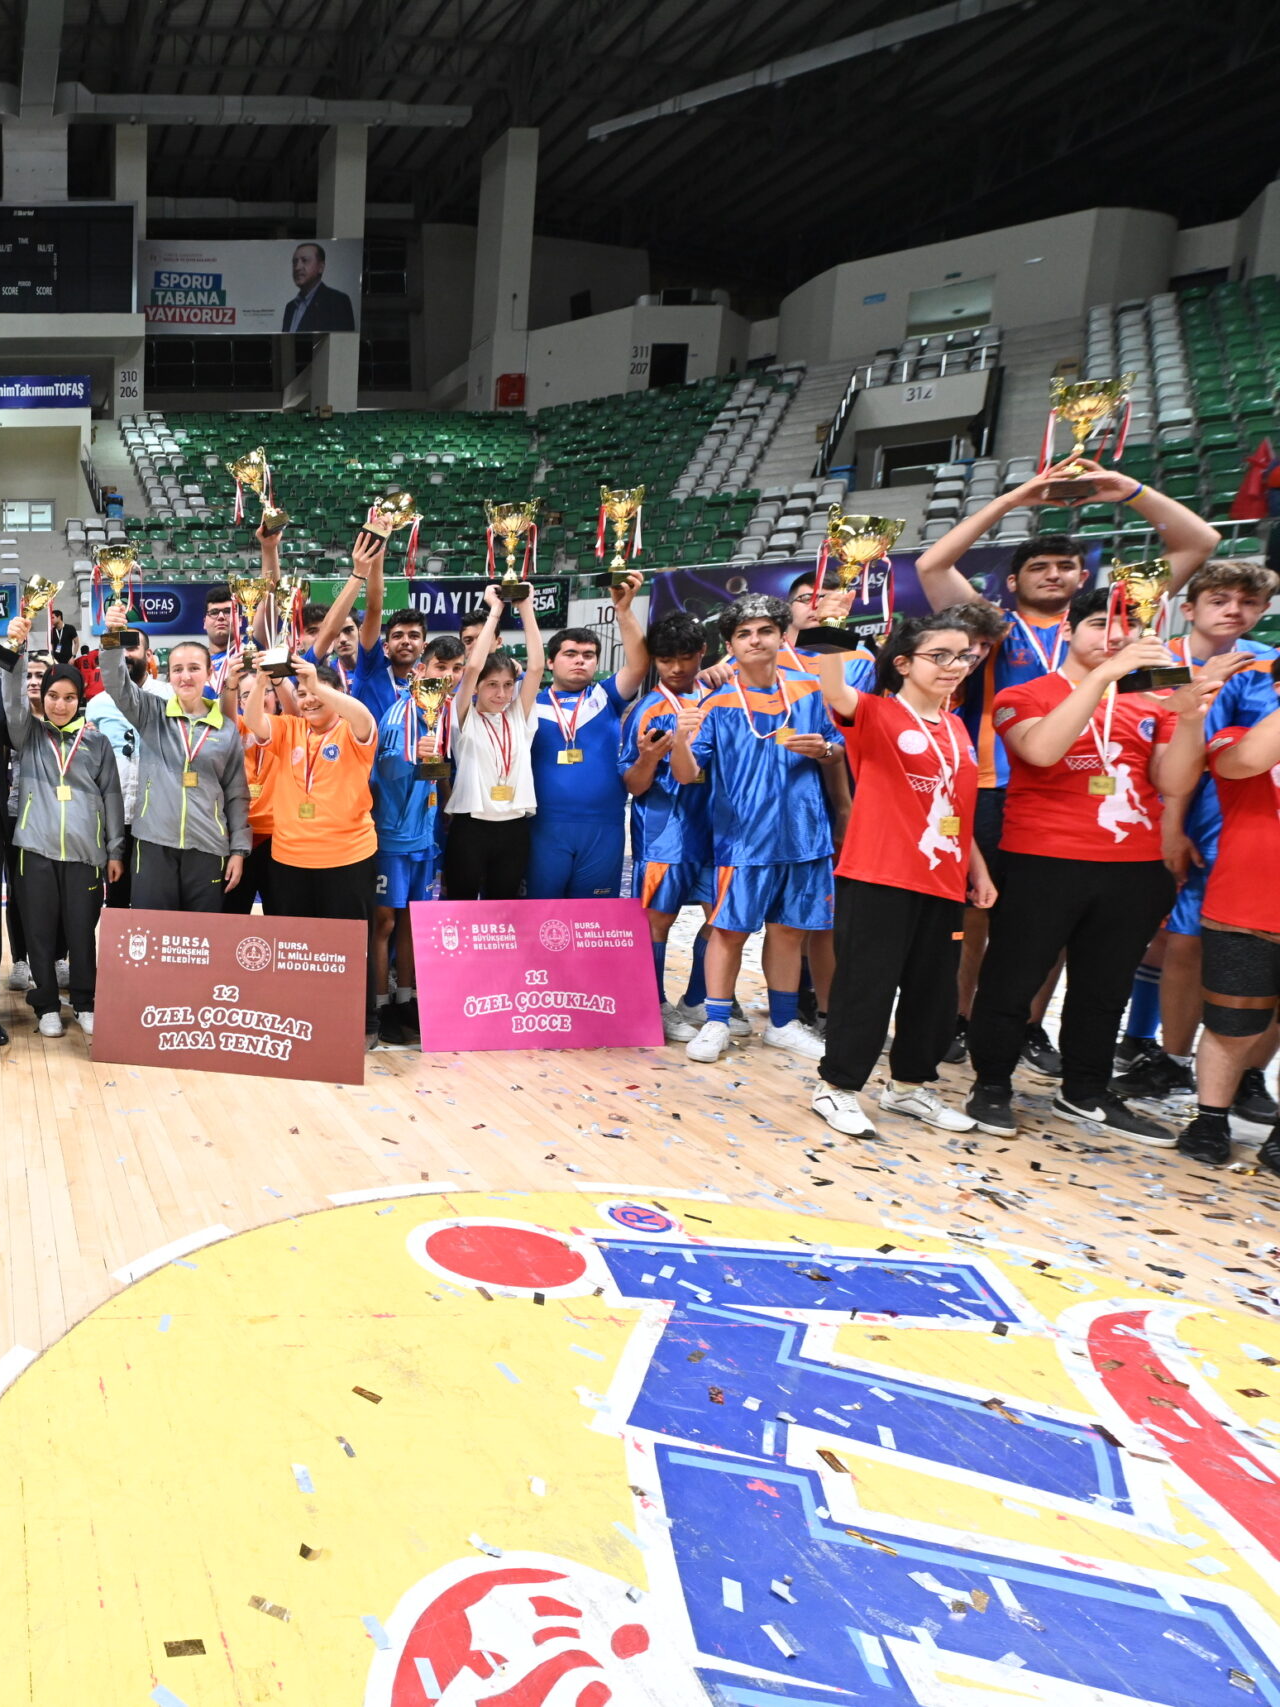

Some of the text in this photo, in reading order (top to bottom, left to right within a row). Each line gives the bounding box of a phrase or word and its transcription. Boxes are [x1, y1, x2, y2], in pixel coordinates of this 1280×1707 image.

[160, 273, 213, 289] SPORU
[2, 287, 18, 296] SCORE
[36, 287, 53, 296] SCORE
[155, 291, 220, 305] TABANA
[145, 307, 234, 323] YAYIYORUZ
[632, 346, 648, 358] 311
[630, 363, 648, 375] 207
[121, 371, 137, 382] 310
[120, 386, 138, 398] 206
[597, 606, 615, 624] 10
[472, 924, 516, 933] BURSA
[574, 922, 600, 930] BURSA
[473, 933, 516, 943] BÜYÜKŞEHİR
[576, 929, 633, 939] İL MİLLİ EĞİTİM
[162, 935, 210, 948] BURSA
[278, 941, 308, 950] BURSA
[473, 940, 518, 950] BELEDİYESİ
[576, 938, 634, 948] MÜDÜRLÜĞÜ
[161, 946, 209, 958] BÜYÜKŞEHİR
[278, 950, 346, 963] İL MİLLİ EĞİTİM
[161, 954, 209, 965] BELEDİYESİ
[277, 960, 346, 973] MÜDÜRLÜĞÜ
[525, 970, 548, 985] 11
[213, 984, 239, 1003] 12
[464, 991, 616, 1017] ÖZEL ÇOCUKLAR
[141, 1006, 313, 1041] ÖZEL ÇOCUKLAR
[512, 1015, 571, 1034] BOCCE
[158, 1031, 293, 1061] MASA TENİSİ
